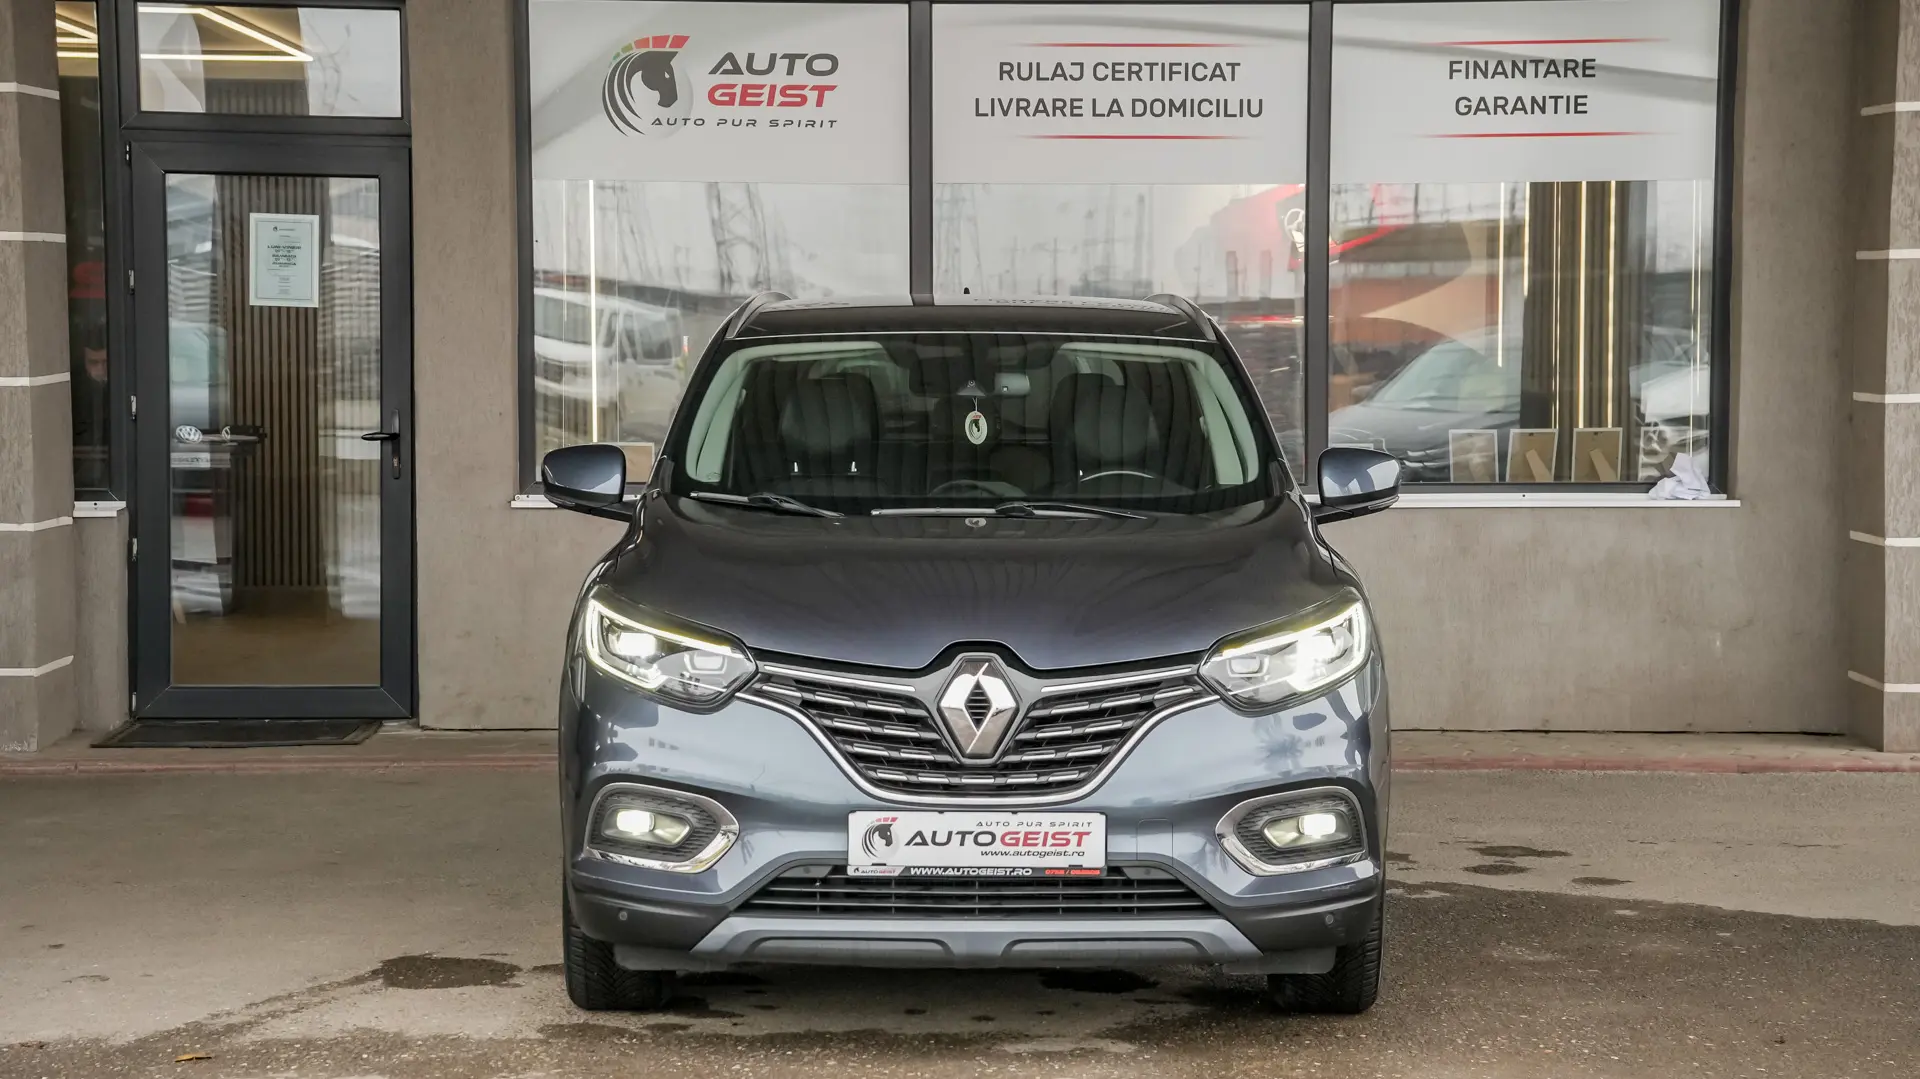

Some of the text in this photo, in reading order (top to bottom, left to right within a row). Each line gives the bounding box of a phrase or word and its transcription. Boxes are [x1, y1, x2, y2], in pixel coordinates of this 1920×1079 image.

[707, 52, 840, 76] AUTO
[999, 61, 1241, 82] RULAJ CERTIFICAT
[1449, 58, 1597, 80] FINANTARE
[707, 83, 838, 108] GEIST
[1454, 94, 1589, 116] GARANTIE
[974, 97, 1264, 118] LIVRARE LA DOMICILIU
[651, 117, 838, 129] AUTO PUR SPIRIT
[980, 849, 1085, 859] www.autogeist.ro
[910, 866, 1033, 877] WWW.AUTOGEIST.RO
